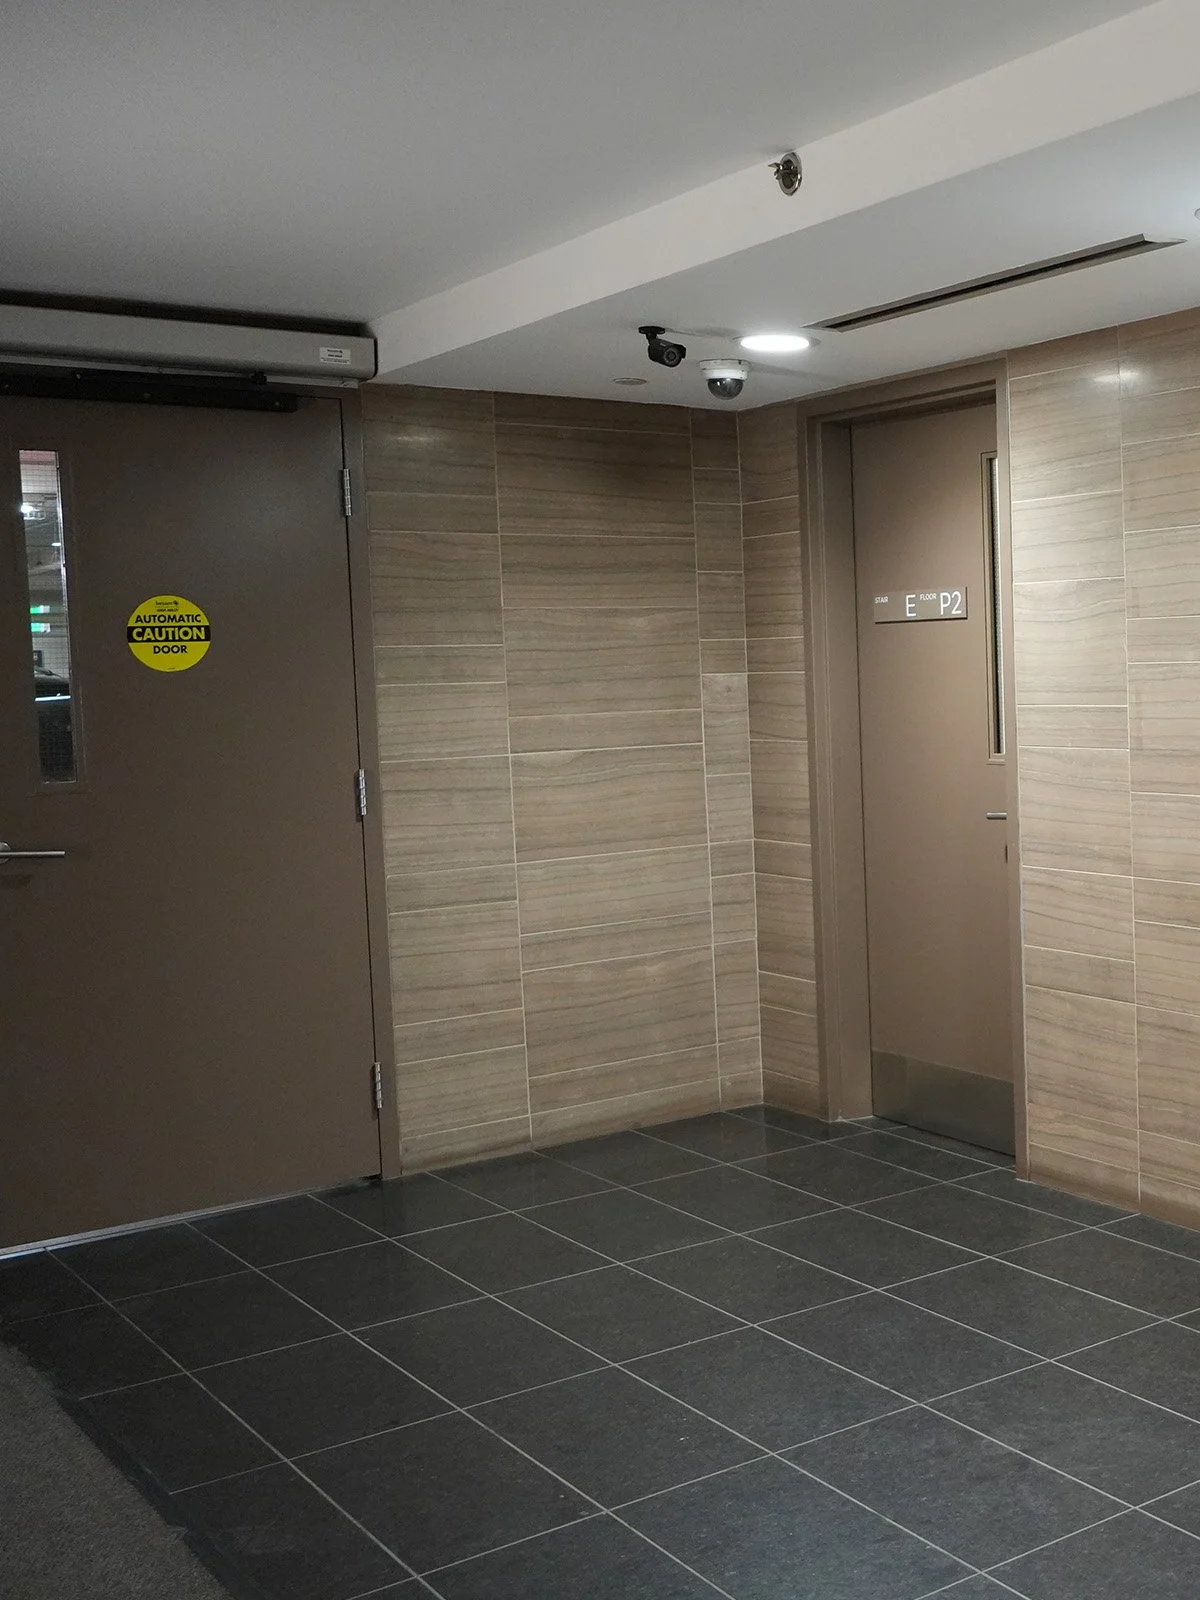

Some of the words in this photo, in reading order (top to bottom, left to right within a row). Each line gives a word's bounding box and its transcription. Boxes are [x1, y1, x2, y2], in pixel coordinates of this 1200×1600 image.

[875, 596, 888, 604] STAIR
[906, 594, 916, 617] E
[940, 591, 962, 615] P2
[135, 614, 201, 623] AUTOMATIC
[132, 627, 205, 641] CAUTION
[153, 645, 187, 654] DOOR
